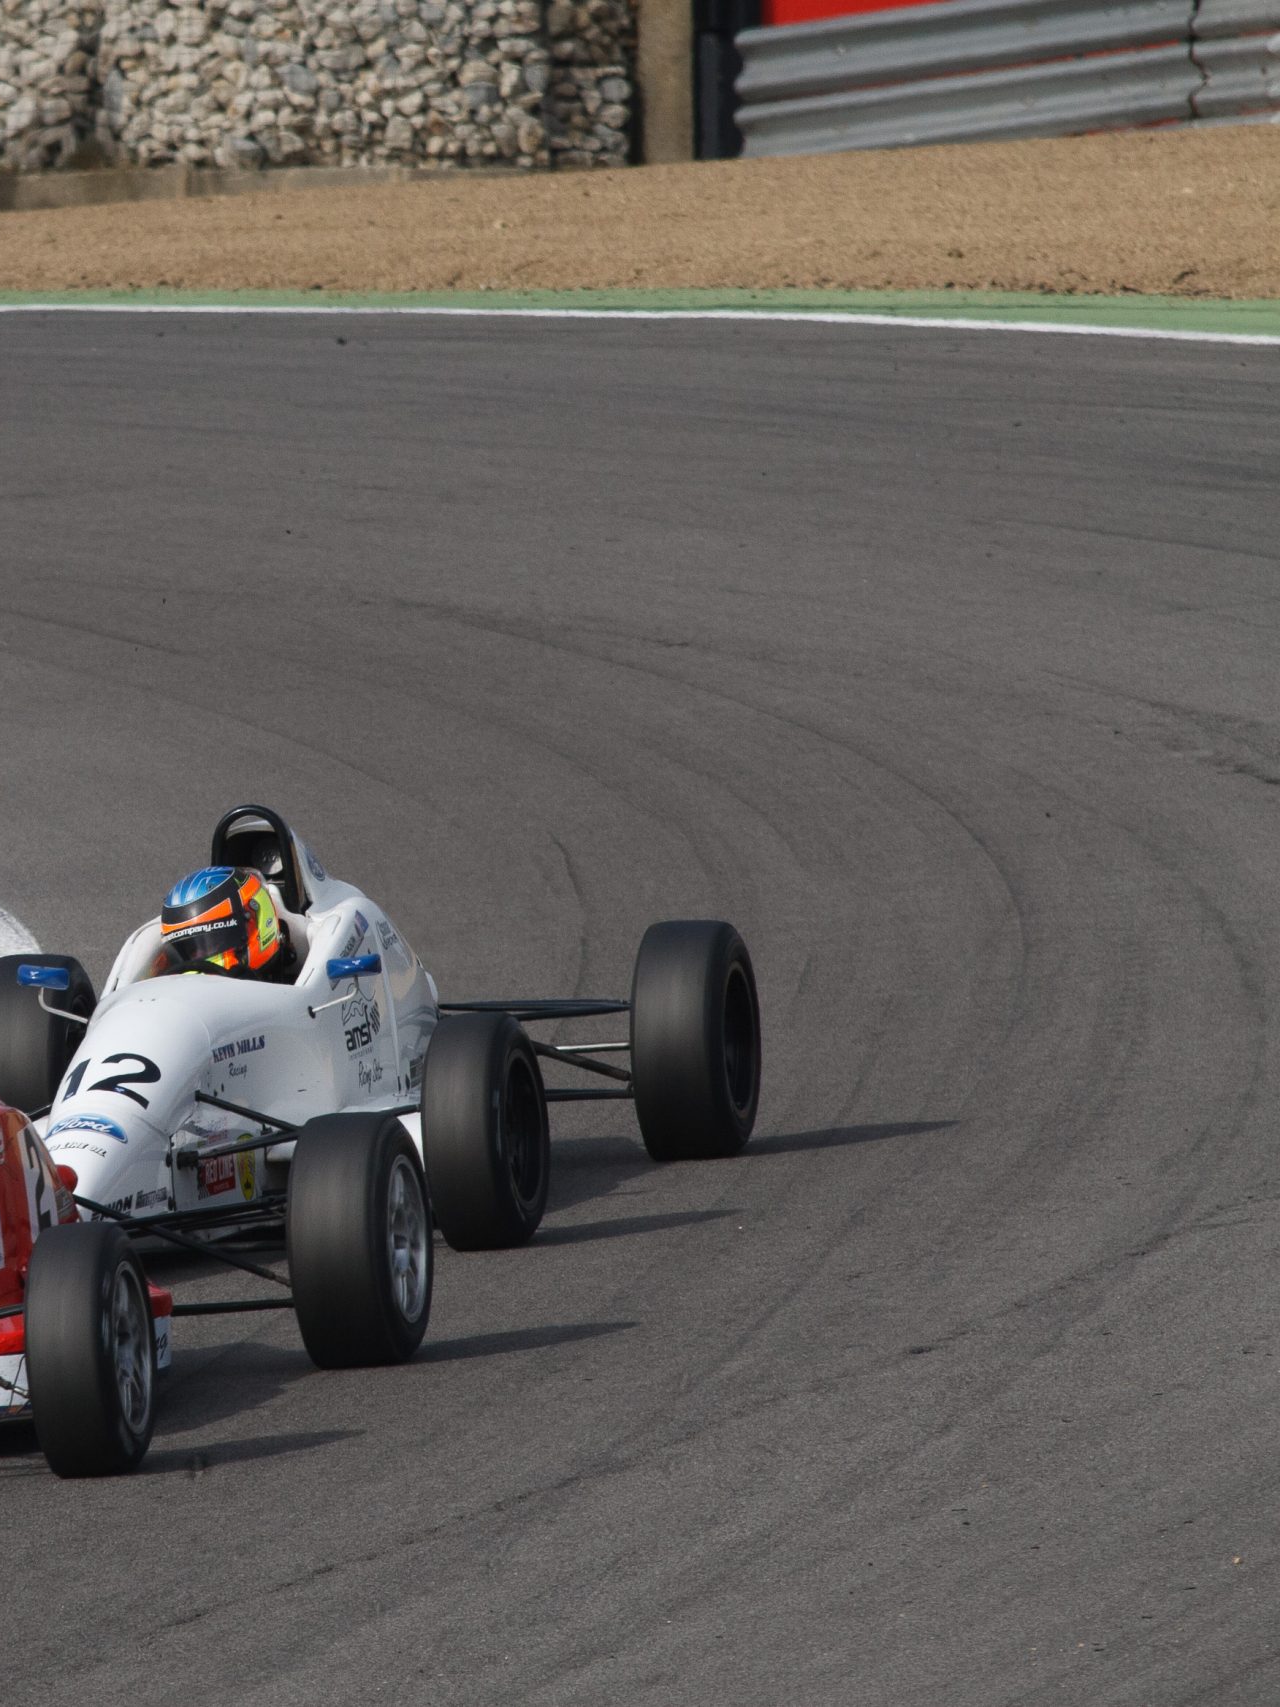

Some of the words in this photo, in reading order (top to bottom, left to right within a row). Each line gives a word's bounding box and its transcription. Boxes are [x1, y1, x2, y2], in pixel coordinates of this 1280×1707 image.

[212, 1042, 235, 1064] KEVIN
[236, 1035, 265, 1055] MILLS
[61, 1053, 161, 1110] 12
[229, 1062, 247, 1080] Racing
[51, 1119, 114, 1136] Ford
